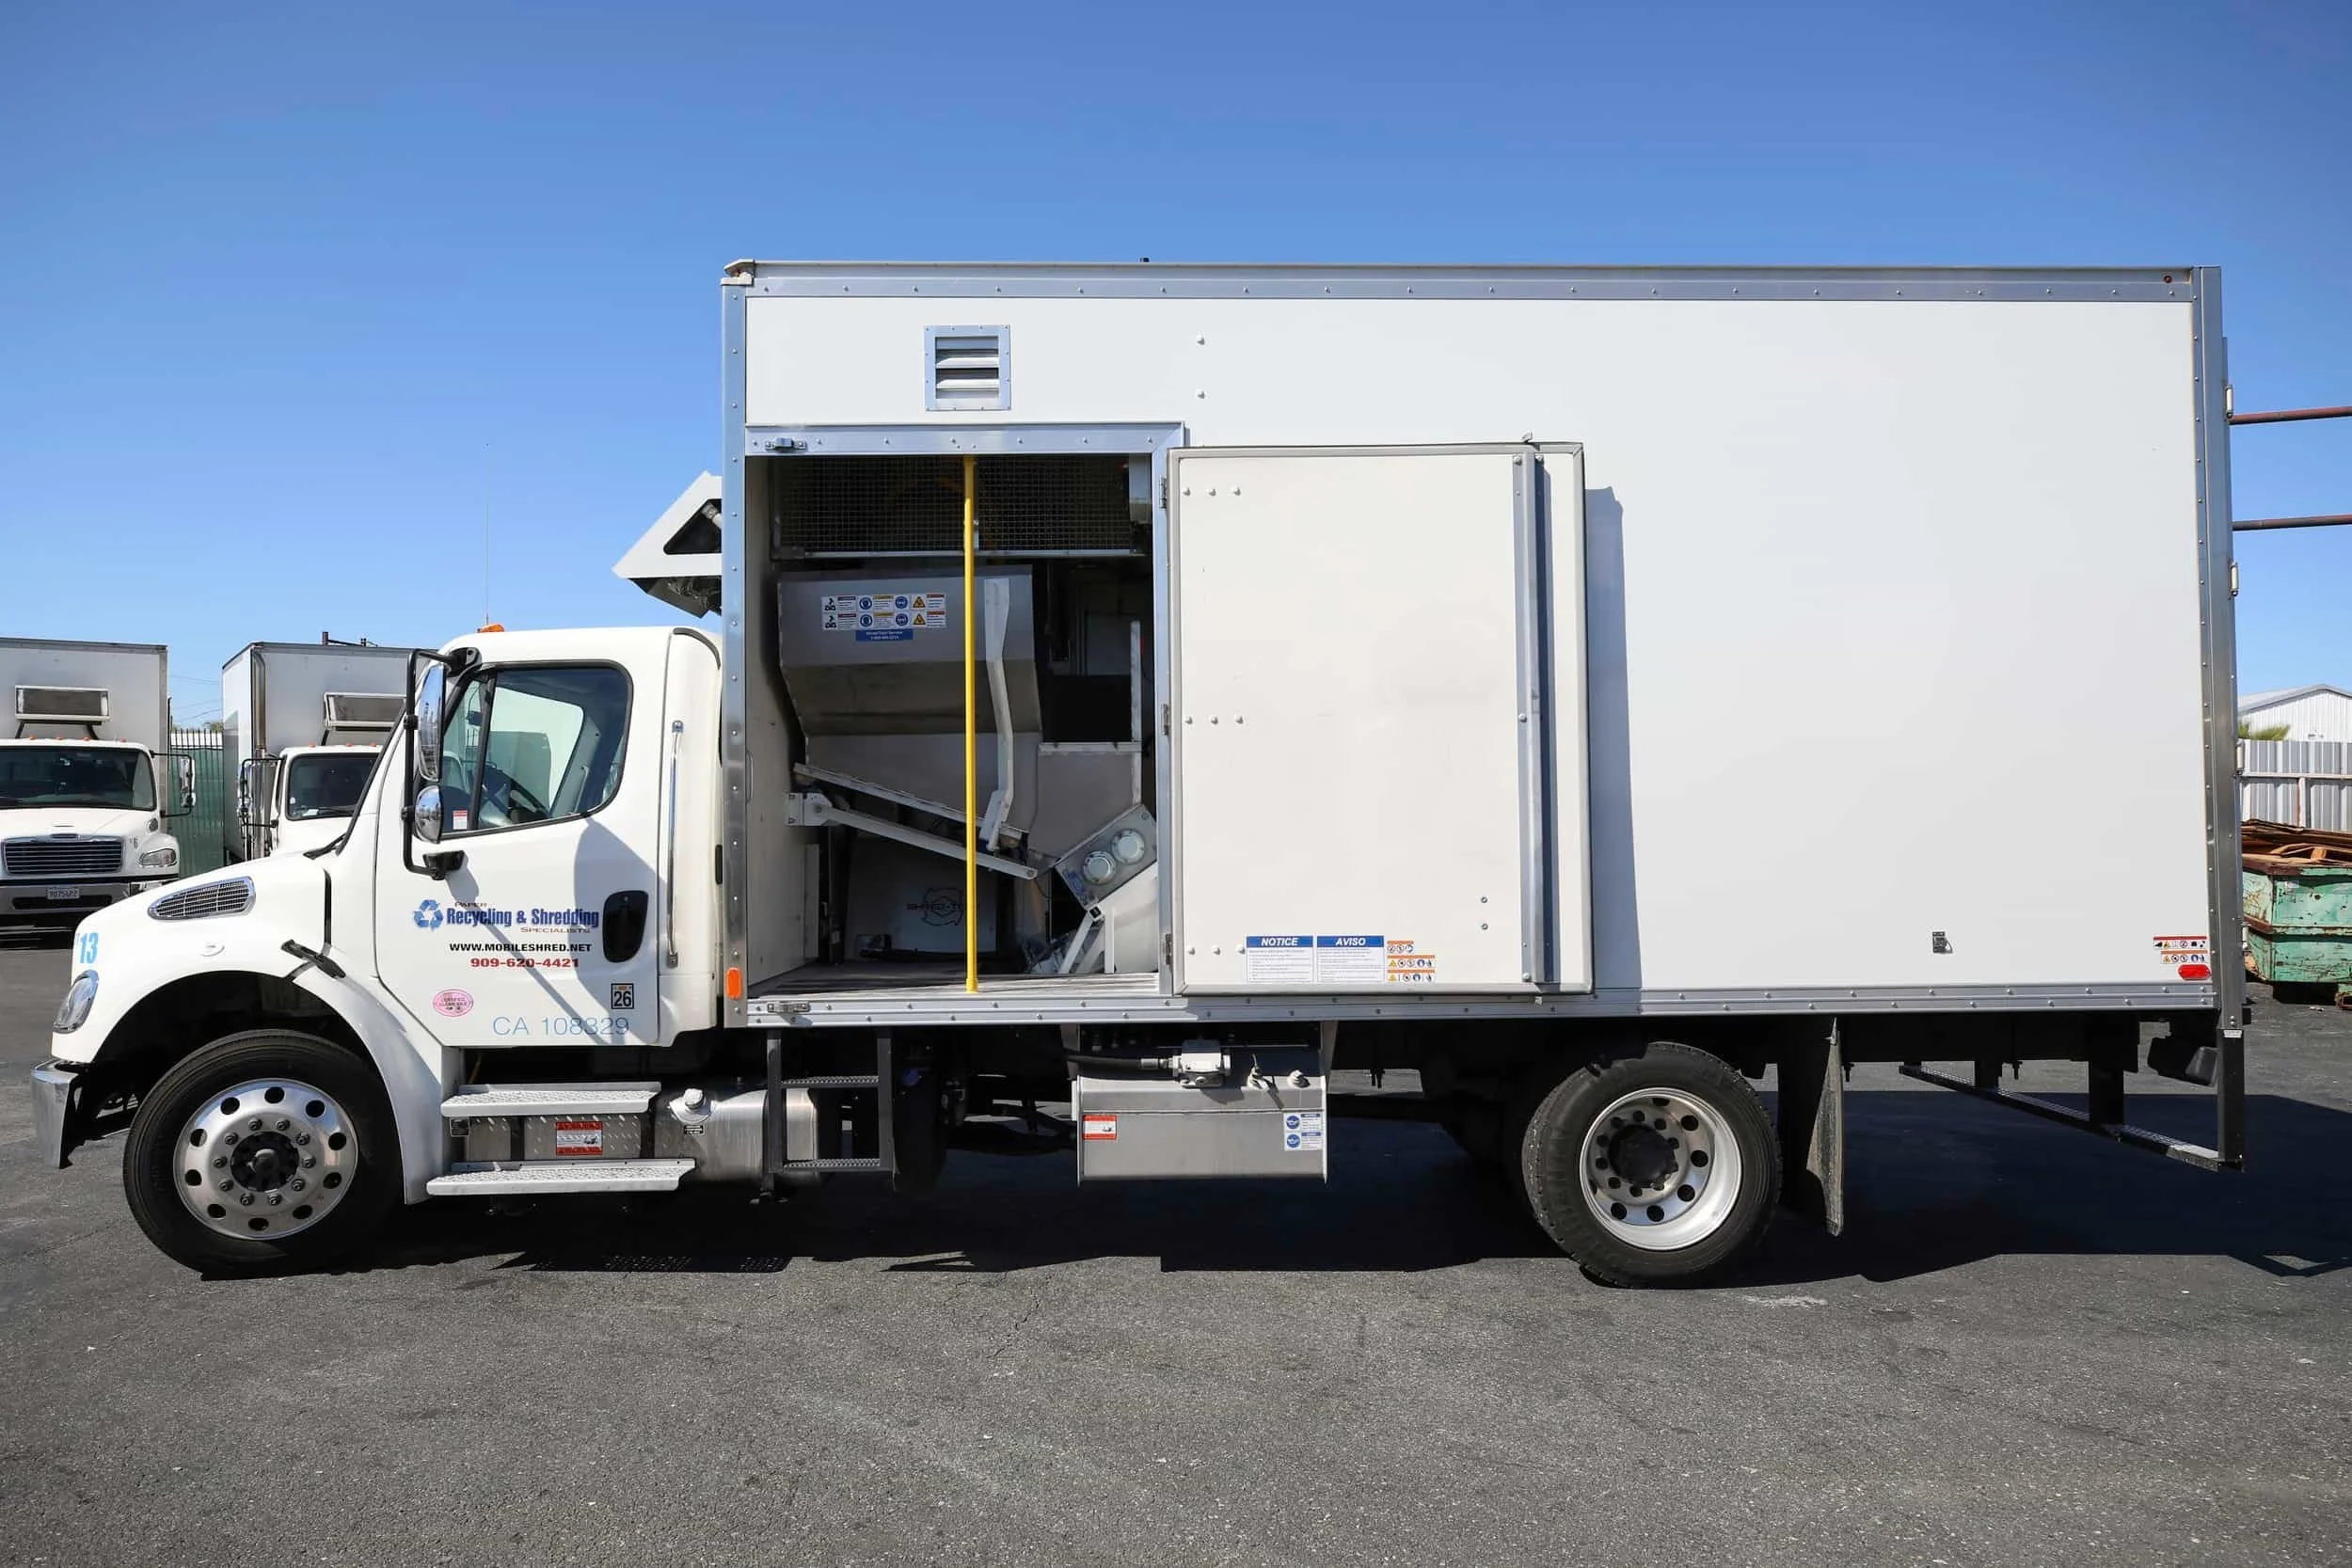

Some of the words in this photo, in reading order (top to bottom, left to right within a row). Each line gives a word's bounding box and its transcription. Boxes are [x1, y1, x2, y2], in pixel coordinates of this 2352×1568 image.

[447, 908, 512, 927] Recycling
[516, 910, 527, 924] &
[532, 908, 599, 928] Shredding
[1261, 937, 1298, 946] NOTICE
[1335, 937, 1366, 946] AVISO
[450, 943, 592, 952] WWW.MOBILESHRED.NET
[470, 958, 580, 968] 909-620-4421
[613, 990, 632, 1007] 26
[493, 1016, 530, 1036] CA
[542, 1016, 629, 1036] 108329
